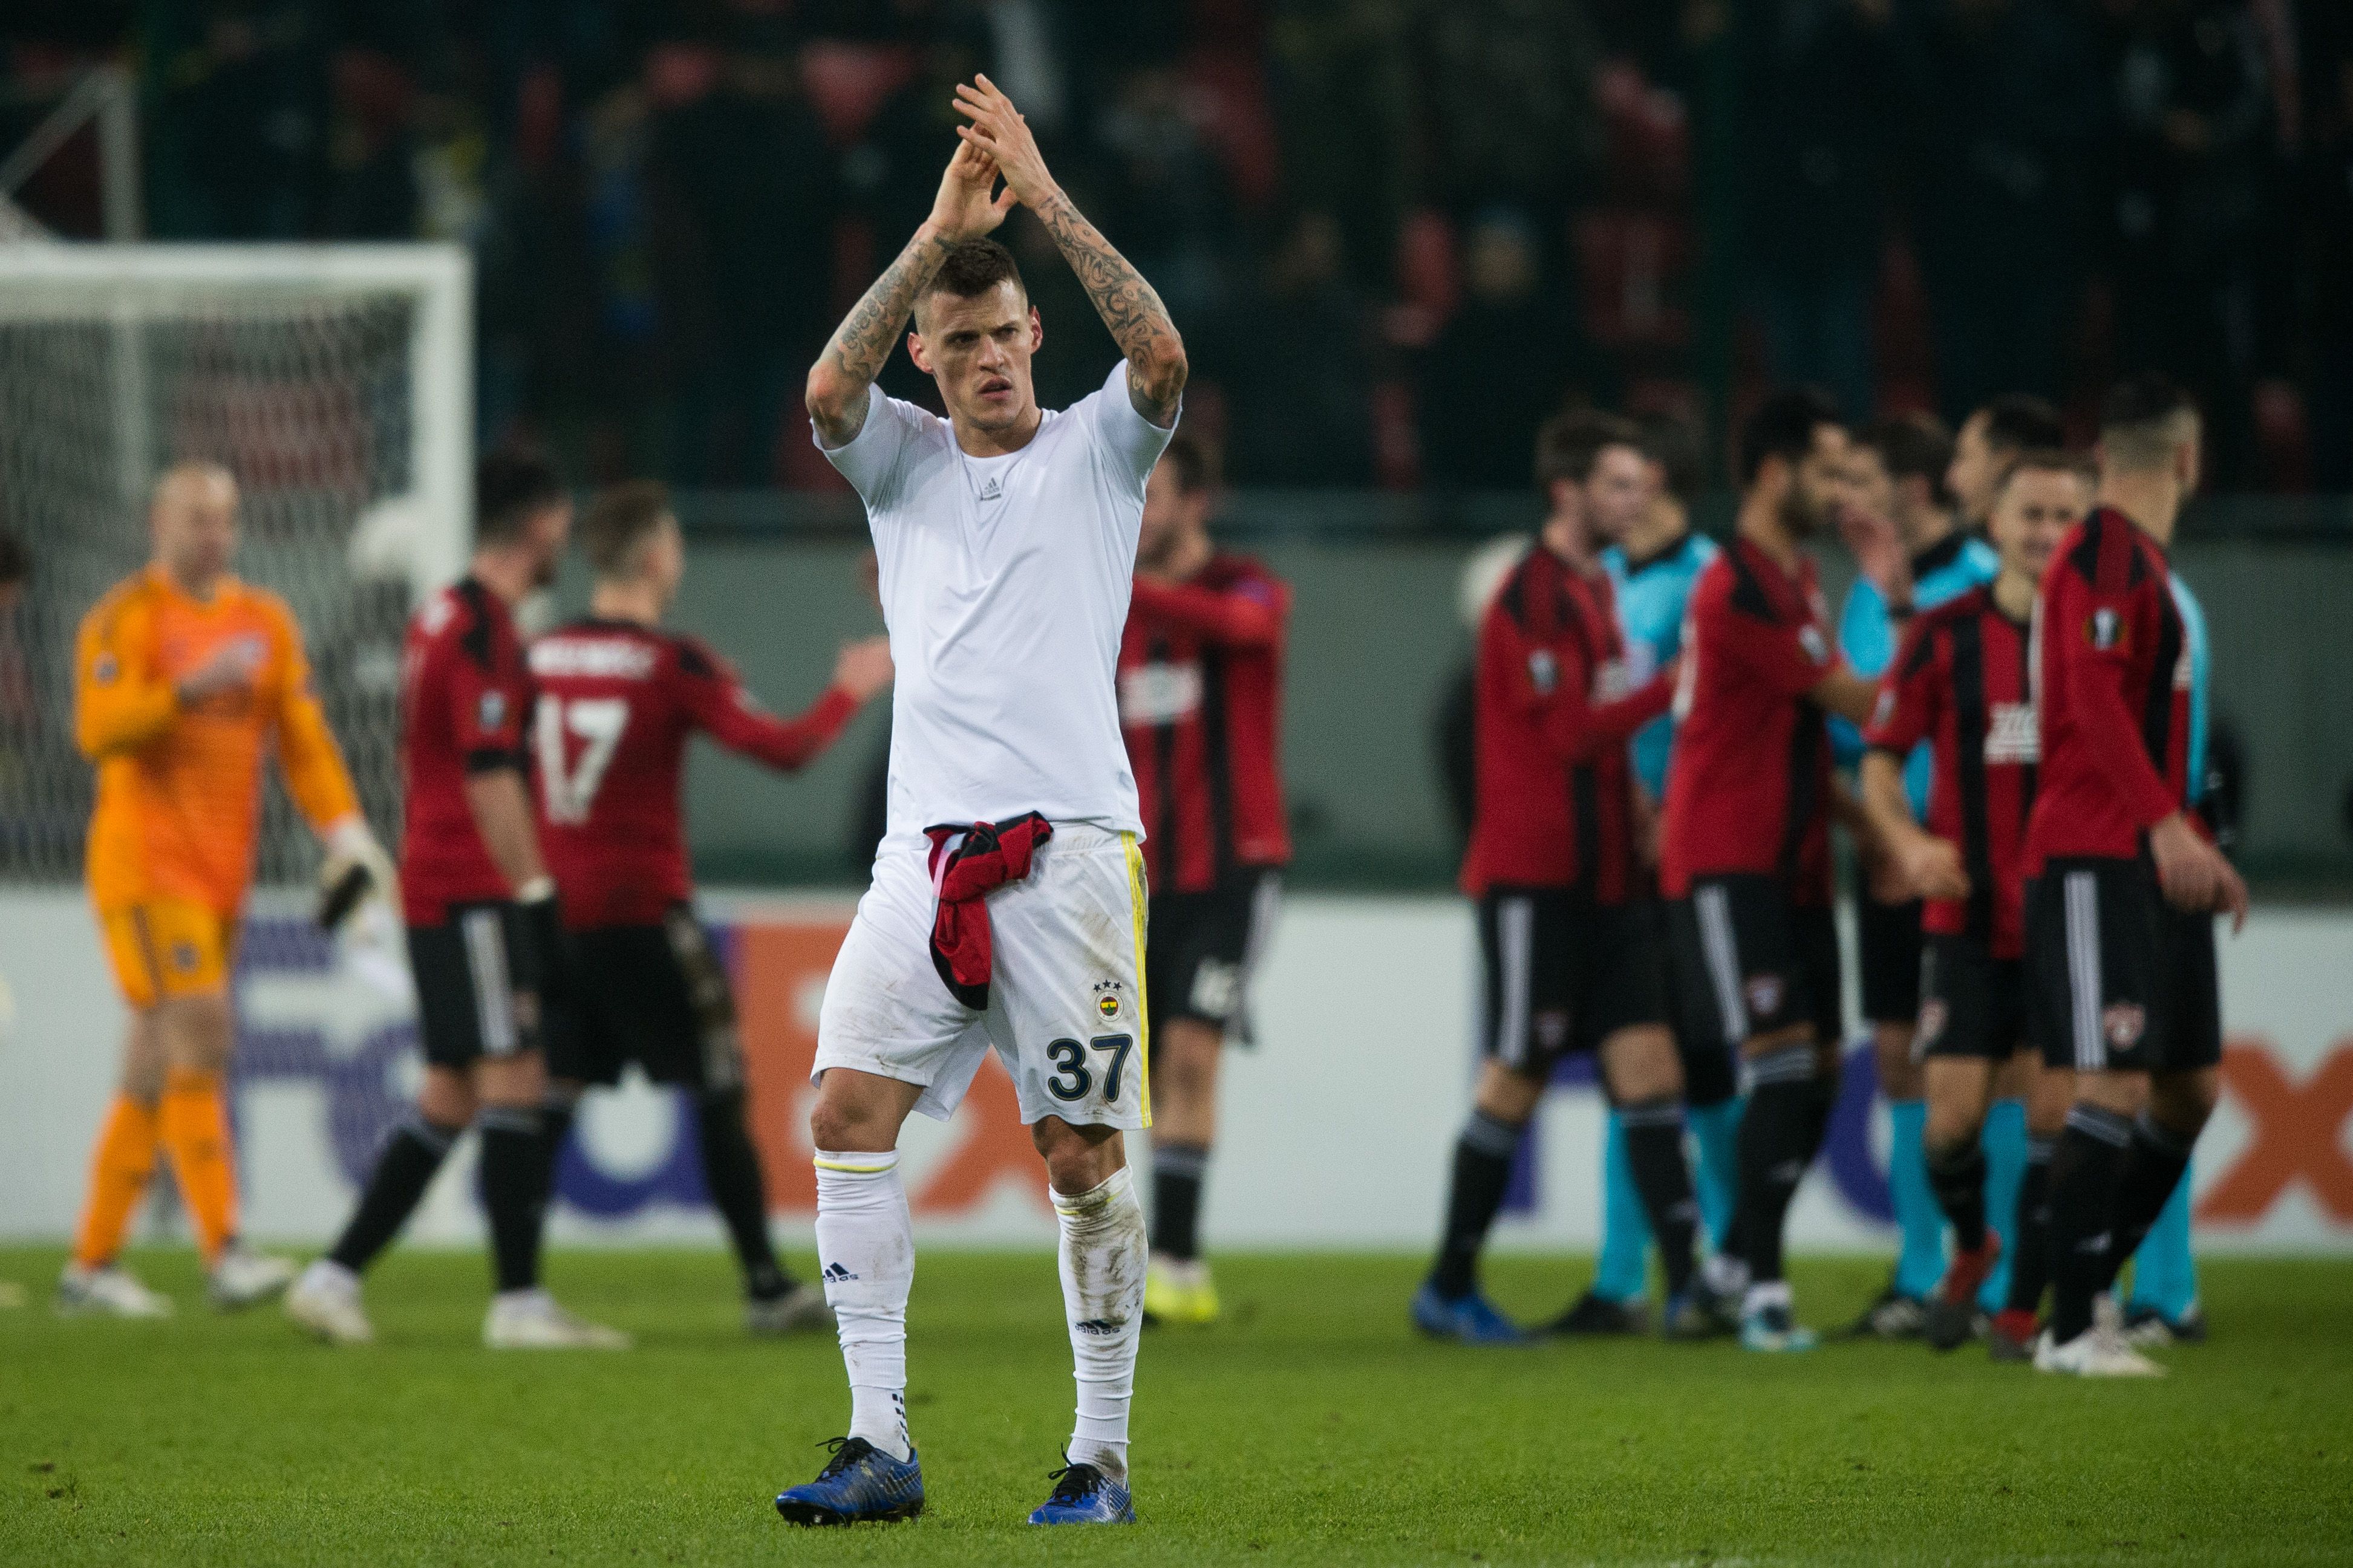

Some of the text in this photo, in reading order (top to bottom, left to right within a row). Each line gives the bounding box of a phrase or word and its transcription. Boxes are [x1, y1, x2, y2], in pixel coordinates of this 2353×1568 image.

[536, 694, 633, 825] 17
[1046, 1033, 1133, 1103] 37
[1074, 1324, 1120, 1335] adidas
